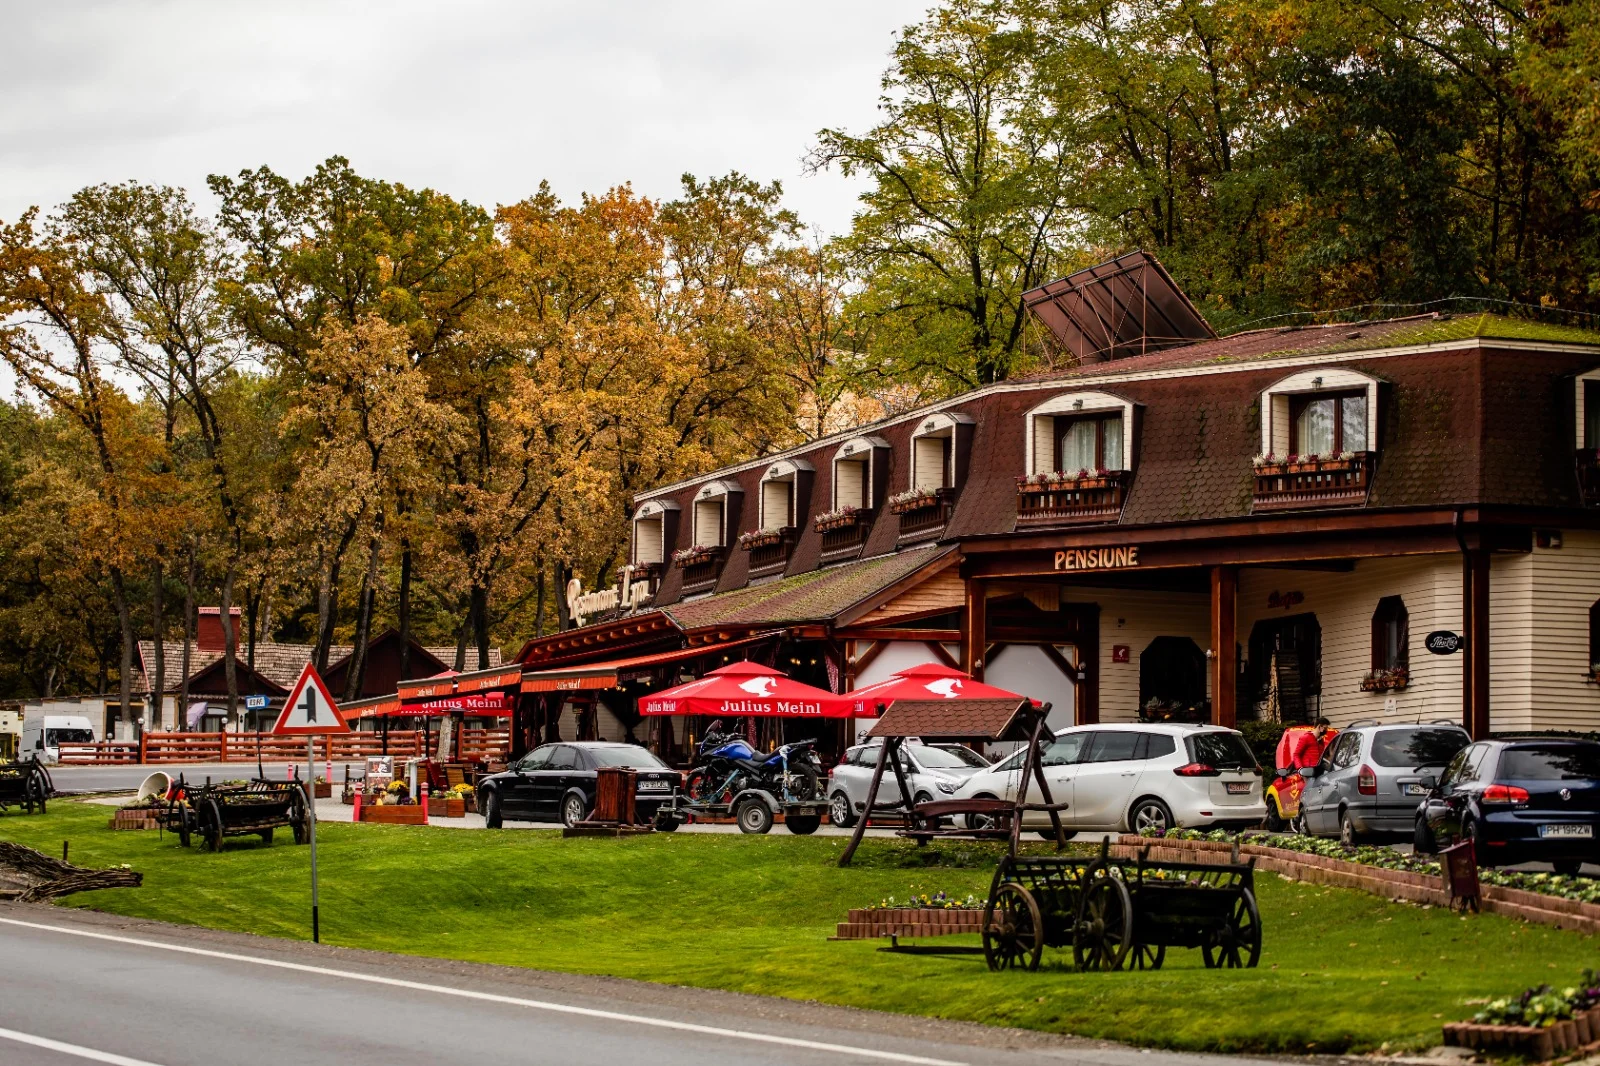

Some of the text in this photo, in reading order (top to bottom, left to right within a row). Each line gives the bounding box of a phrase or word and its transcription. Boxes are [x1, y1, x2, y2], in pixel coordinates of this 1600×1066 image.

[1054, 547, 1138, 570] PENSIUNE
[466, 699, 502, 708] Meinl
[646, 700, 676, 712] Julius Meinl
[720, 700, 821, 714] Julius Meinl
